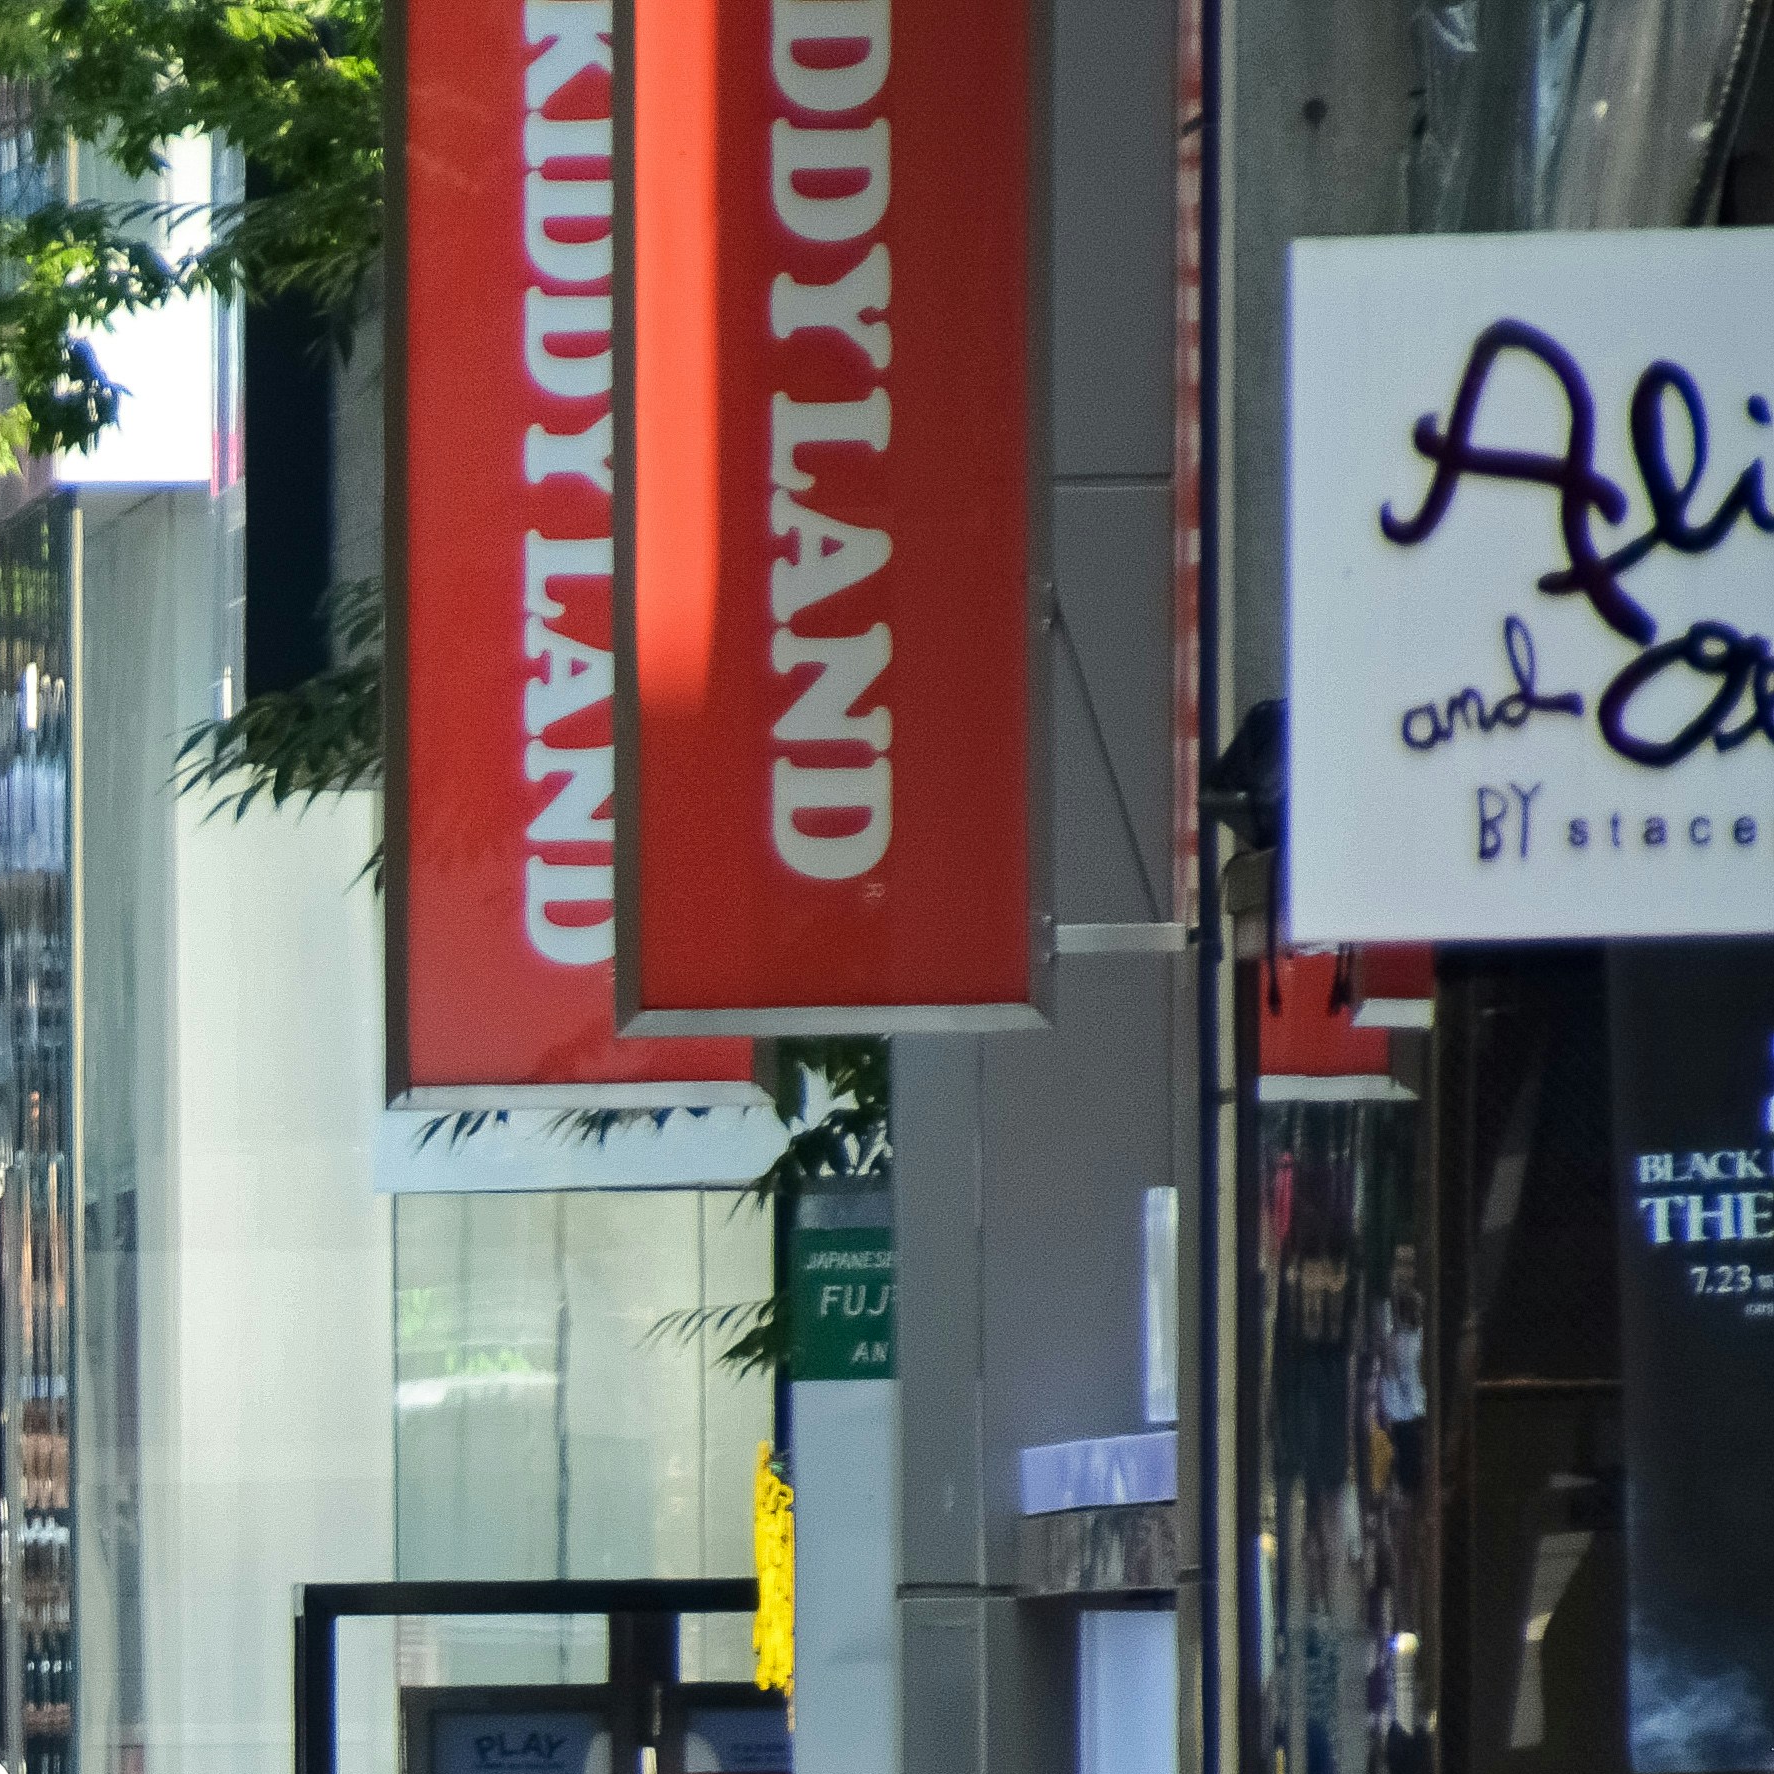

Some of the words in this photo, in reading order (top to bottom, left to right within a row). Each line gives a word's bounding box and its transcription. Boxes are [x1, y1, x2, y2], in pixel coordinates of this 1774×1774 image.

[523, 0, 614, 496] KIDDY
[770, 388, 894, 881] LAND
[1401, 614, 1586, 754] and
[523, 528, 614, 969] LAND
[1476, 783, 1542, 861] BY
[1566, 811, 1757, 849] stace
[1637, 1149, 1765, 1183] BLACK
[1639, 1191, 1774, 1243] THE
[1690, 1264, 1753, 1293] 7.23
[474, 1731, 566, 1763] PLAY
